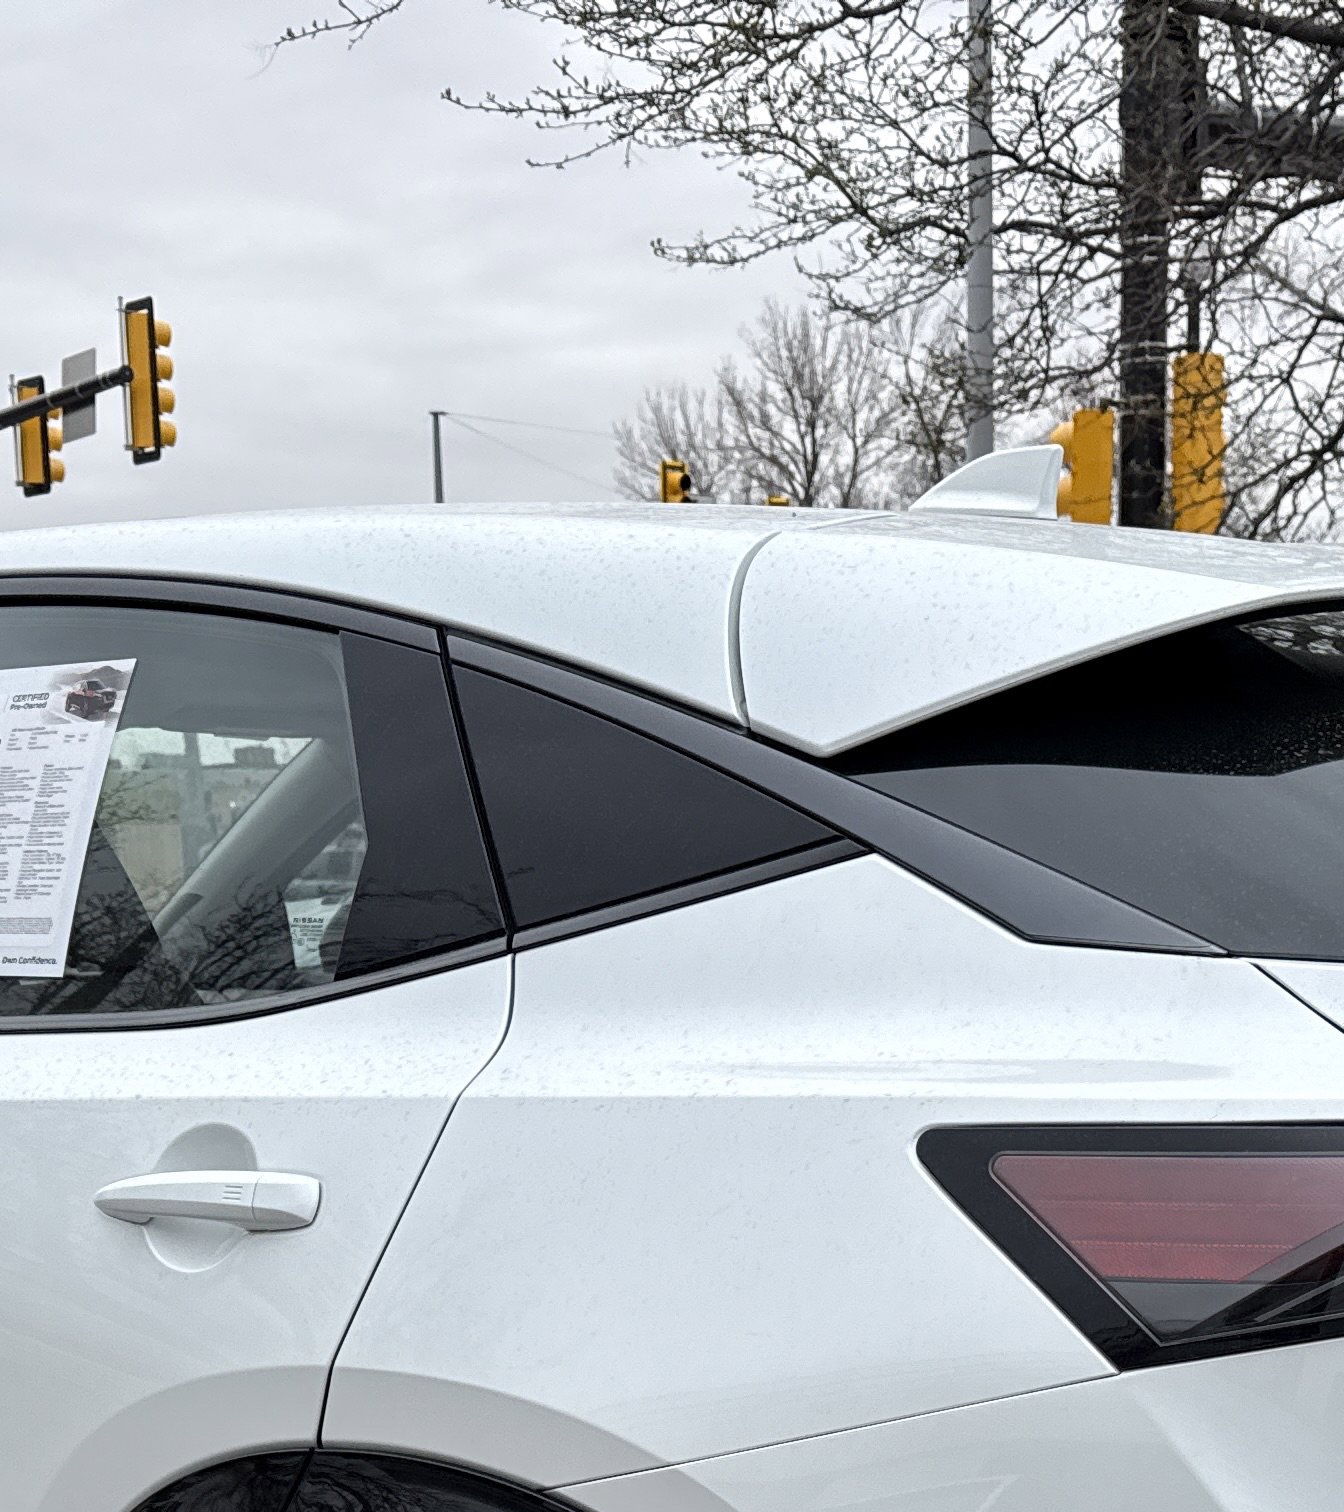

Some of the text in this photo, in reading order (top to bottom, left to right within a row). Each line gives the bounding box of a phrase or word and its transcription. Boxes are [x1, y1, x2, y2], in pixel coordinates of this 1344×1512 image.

[12, 692, 50, 702] CERTIFIED
[2, 956, 17, 964] Own
[18, 956, 57, 965] Confidence.
